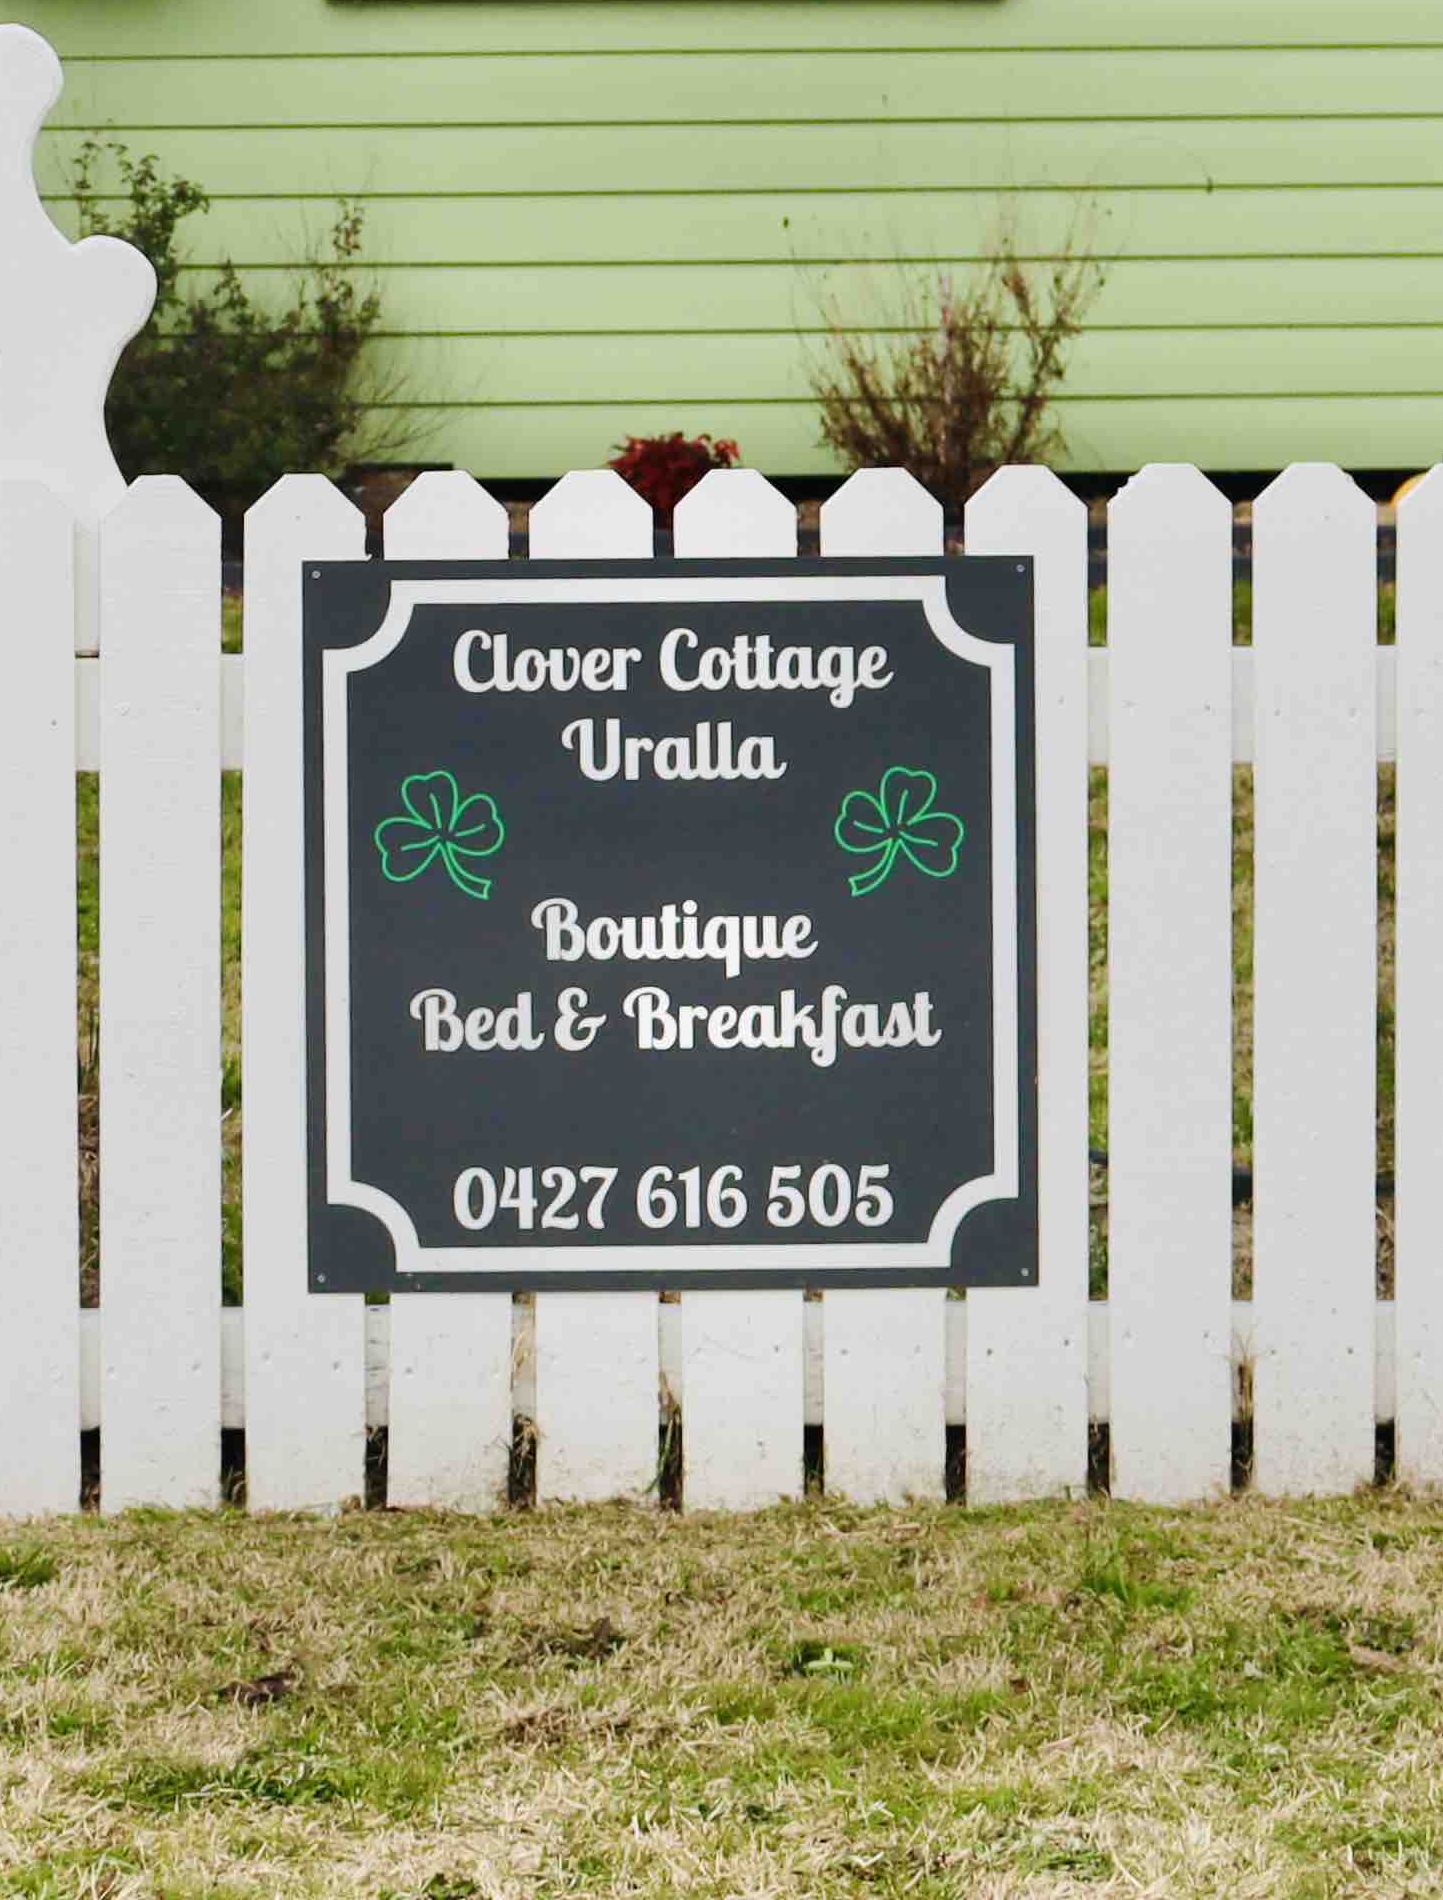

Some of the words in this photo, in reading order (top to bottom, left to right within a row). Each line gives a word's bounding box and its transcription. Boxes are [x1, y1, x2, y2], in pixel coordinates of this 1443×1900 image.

[453, 629, 642, 693] Clover
[659, 627, 894, 709] Cottage
[561, 718, 787, 782] Uralla
[530, 897, 819, 979] Boutique
[409, 988, 545, 1052] Bed
[554, 986, 607, 1052] &
[622, 984, 943, 1068] Breakfast
[453, 1166, 619, 1230] 0427
[636, 1164, 748, 1230] 616
[766, 1163, 895, 1229] 505
